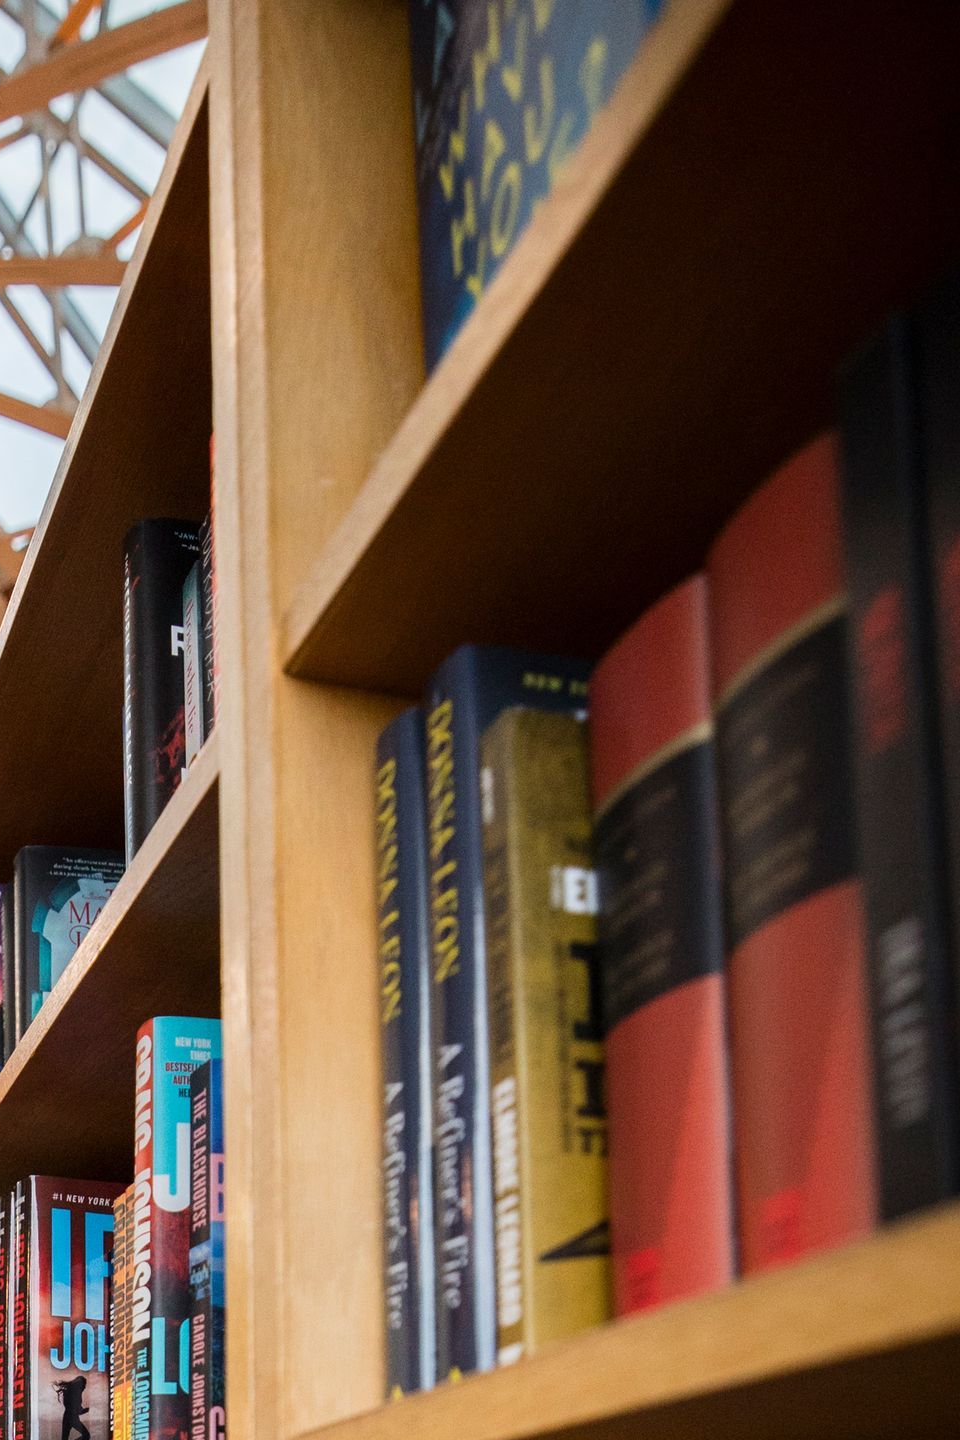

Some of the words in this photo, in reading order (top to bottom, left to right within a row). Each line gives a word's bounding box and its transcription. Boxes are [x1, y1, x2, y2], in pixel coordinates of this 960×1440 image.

[175, 1037, 191, 1048] NEW
[193, 1038, 211, 1049] YORK
[190, 1050, 211, 1062] TIMES
[135, 1035, 152, 1156] CRAIG
[193, 1088, 207, 1124] THE
[52, 1193, 63, 1201] #1
[66, 1194, 85, 1204] NEW
[88, 1196, 110, 1206] YORK
[192, 1126, 207, 1232] BLACKHOUSE
[132, 1165, 152, 1345] JOHNSON
[13, 1293, 25, 1409] JOHANSEN
[136, 1347, 147, 1369] THE
[192, 1314, 206, 1369] CAROLE
